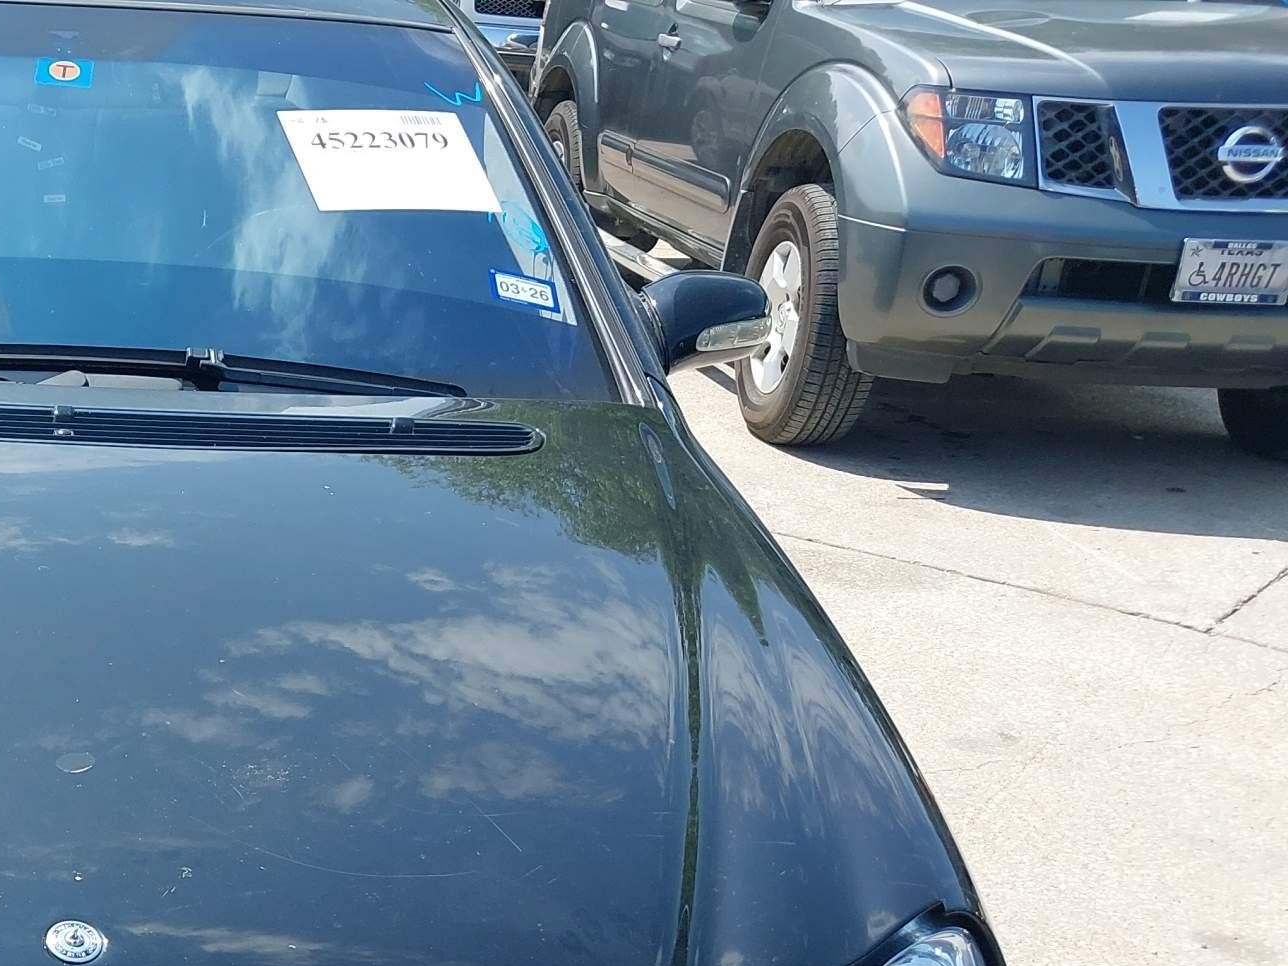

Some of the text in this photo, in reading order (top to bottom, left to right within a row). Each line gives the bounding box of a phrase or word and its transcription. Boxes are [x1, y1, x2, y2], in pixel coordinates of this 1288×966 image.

[310, 131, 449, 150] 45223079
[1227, 148, 1279, 158] NISSAN
[1211, 261, 1281, 289] 4RHGT
[1199, 292, 1259, 303] COWBOYS
